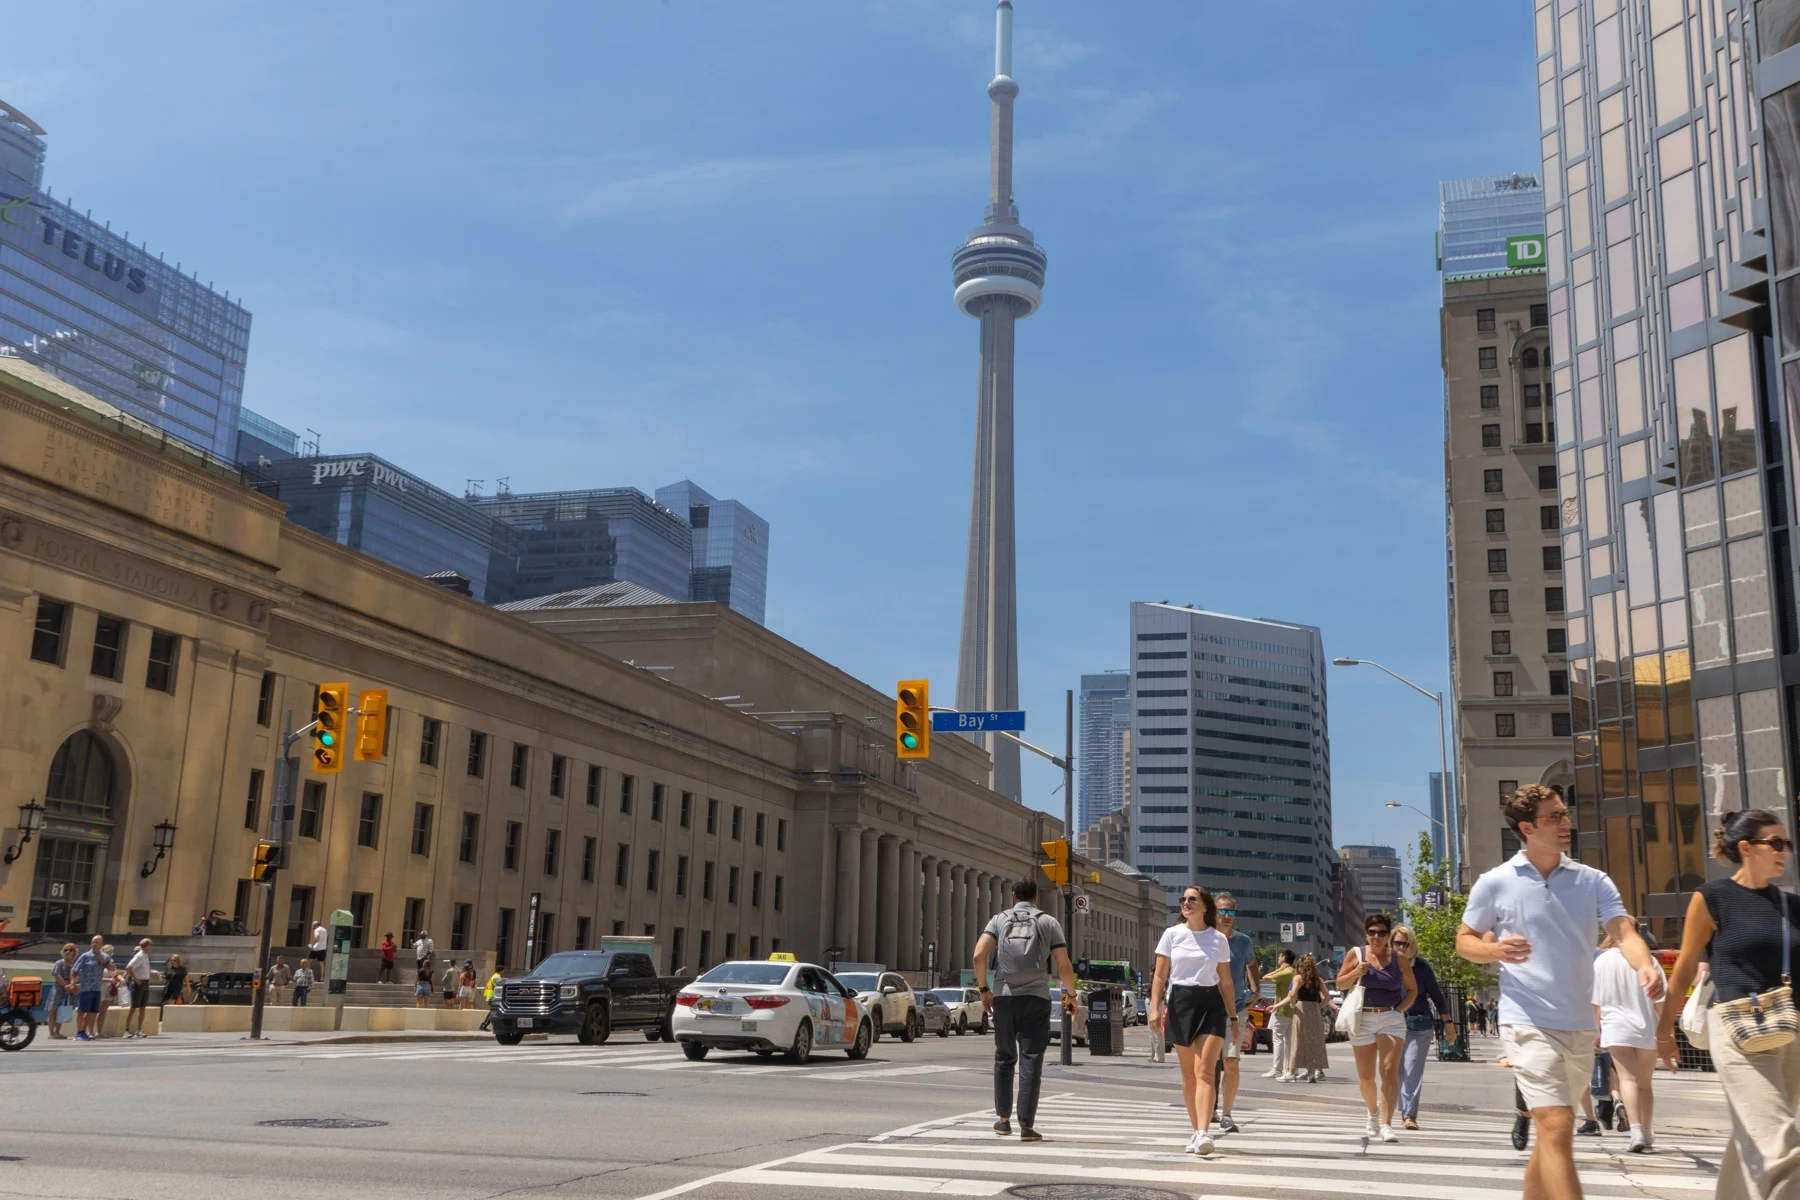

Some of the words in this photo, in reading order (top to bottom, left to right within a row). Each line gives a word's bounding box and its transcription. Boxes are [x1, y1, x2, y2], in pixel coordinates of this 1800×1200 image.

[41, 215, 146, 294] TELUS
[1510, 239, 1542, 260] TD
[46, 430, 81, 454] HILL
[312, 459, 367, 485] pwc
[370, 461, 408, 492] pwc
[34, 536, 102, 573] POSTAL
[112, 562, 180, 600] STATION
[958, 713, 985, 730] Bay
[990, 713, 998, 721] St
[51, 882, 65, 897] 61
